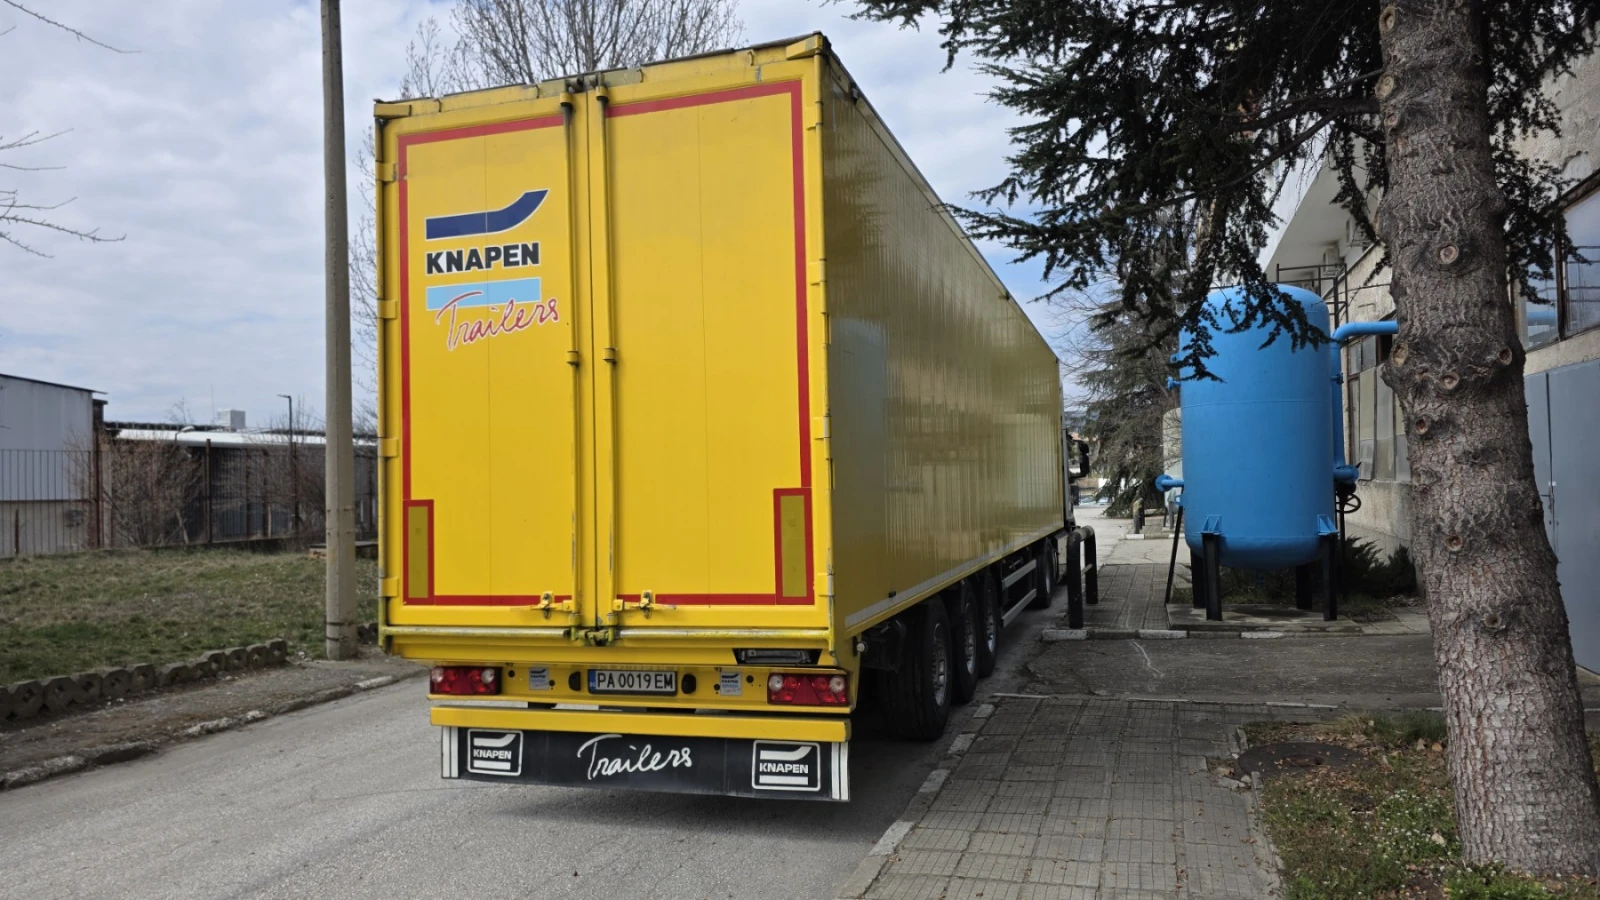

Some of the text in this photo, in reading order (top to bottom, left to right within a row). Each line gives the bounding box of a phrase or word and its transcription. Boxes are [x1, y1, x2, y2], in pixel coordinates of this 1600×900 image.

[426, 242, 540, 275] KNAPEN
[435, 290, 559, 351] Trailers
[597, 672, 615, 688] PA
[618, 673, 652, 689] 0019
[654, 673, 673, 690] EM
[473, 749, 512, 760] KNAPEN
[577, 733, 692, 780] Trailers
[759, 762, 809, 774] KNAPEN
